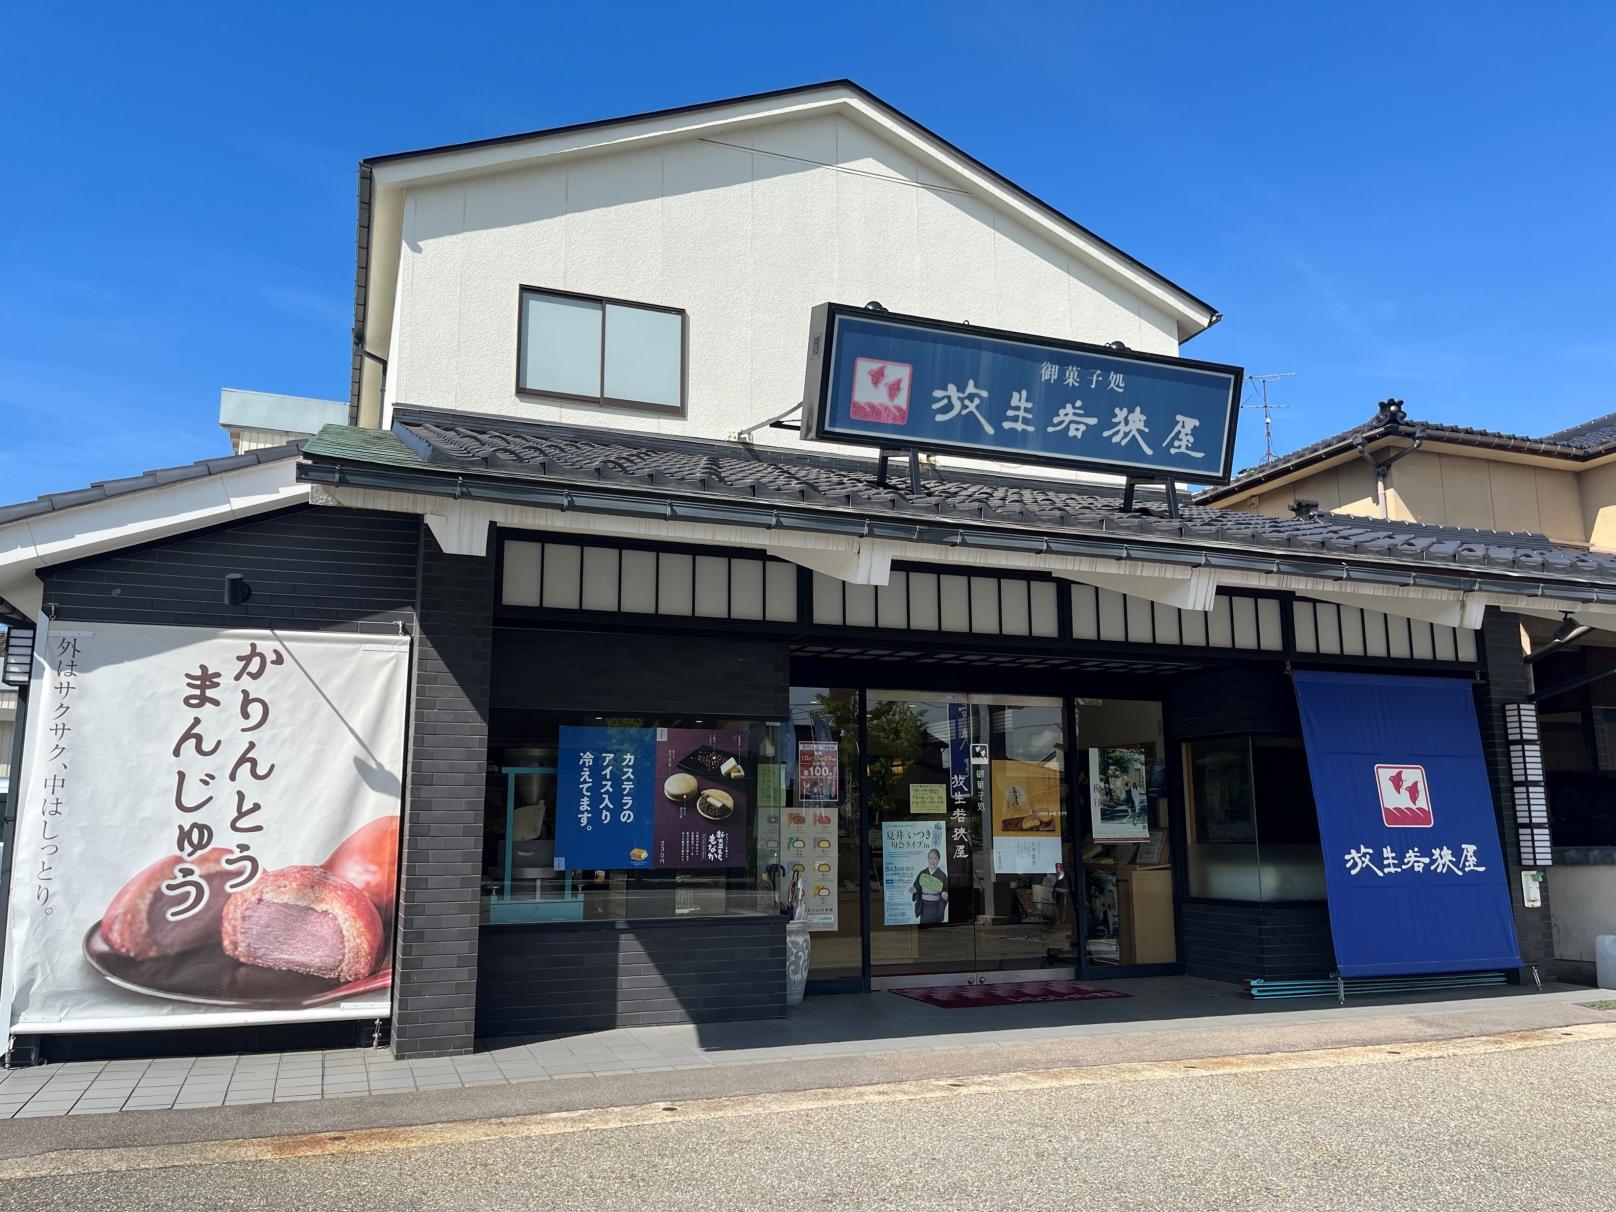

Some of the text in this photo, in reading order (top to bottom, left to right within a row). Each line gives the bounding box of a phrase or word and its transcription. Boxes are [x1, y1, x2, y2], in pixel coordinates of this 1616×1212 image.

[1039, 360, 1126, 393] 御菓子処
[931, 378, 1206, 459] 放生若狭屋
[35, 636, 81, 918] 外はサクサク、中はしっとり。
[164, 663, 222, 919] まんじゅう
[224, 641, 285, 890] かりんとう
[577, 751, 595, 831] 冷えてます。
[599, 752, 615, 824] アイス入り
[620, 752, 635, 823] カステラの
[975, 769, 986, 812] 御菓子処
[886, 829, 932, 841] 夏井いつき
[1344, 843, 1487, 877] 放生若狭屋
